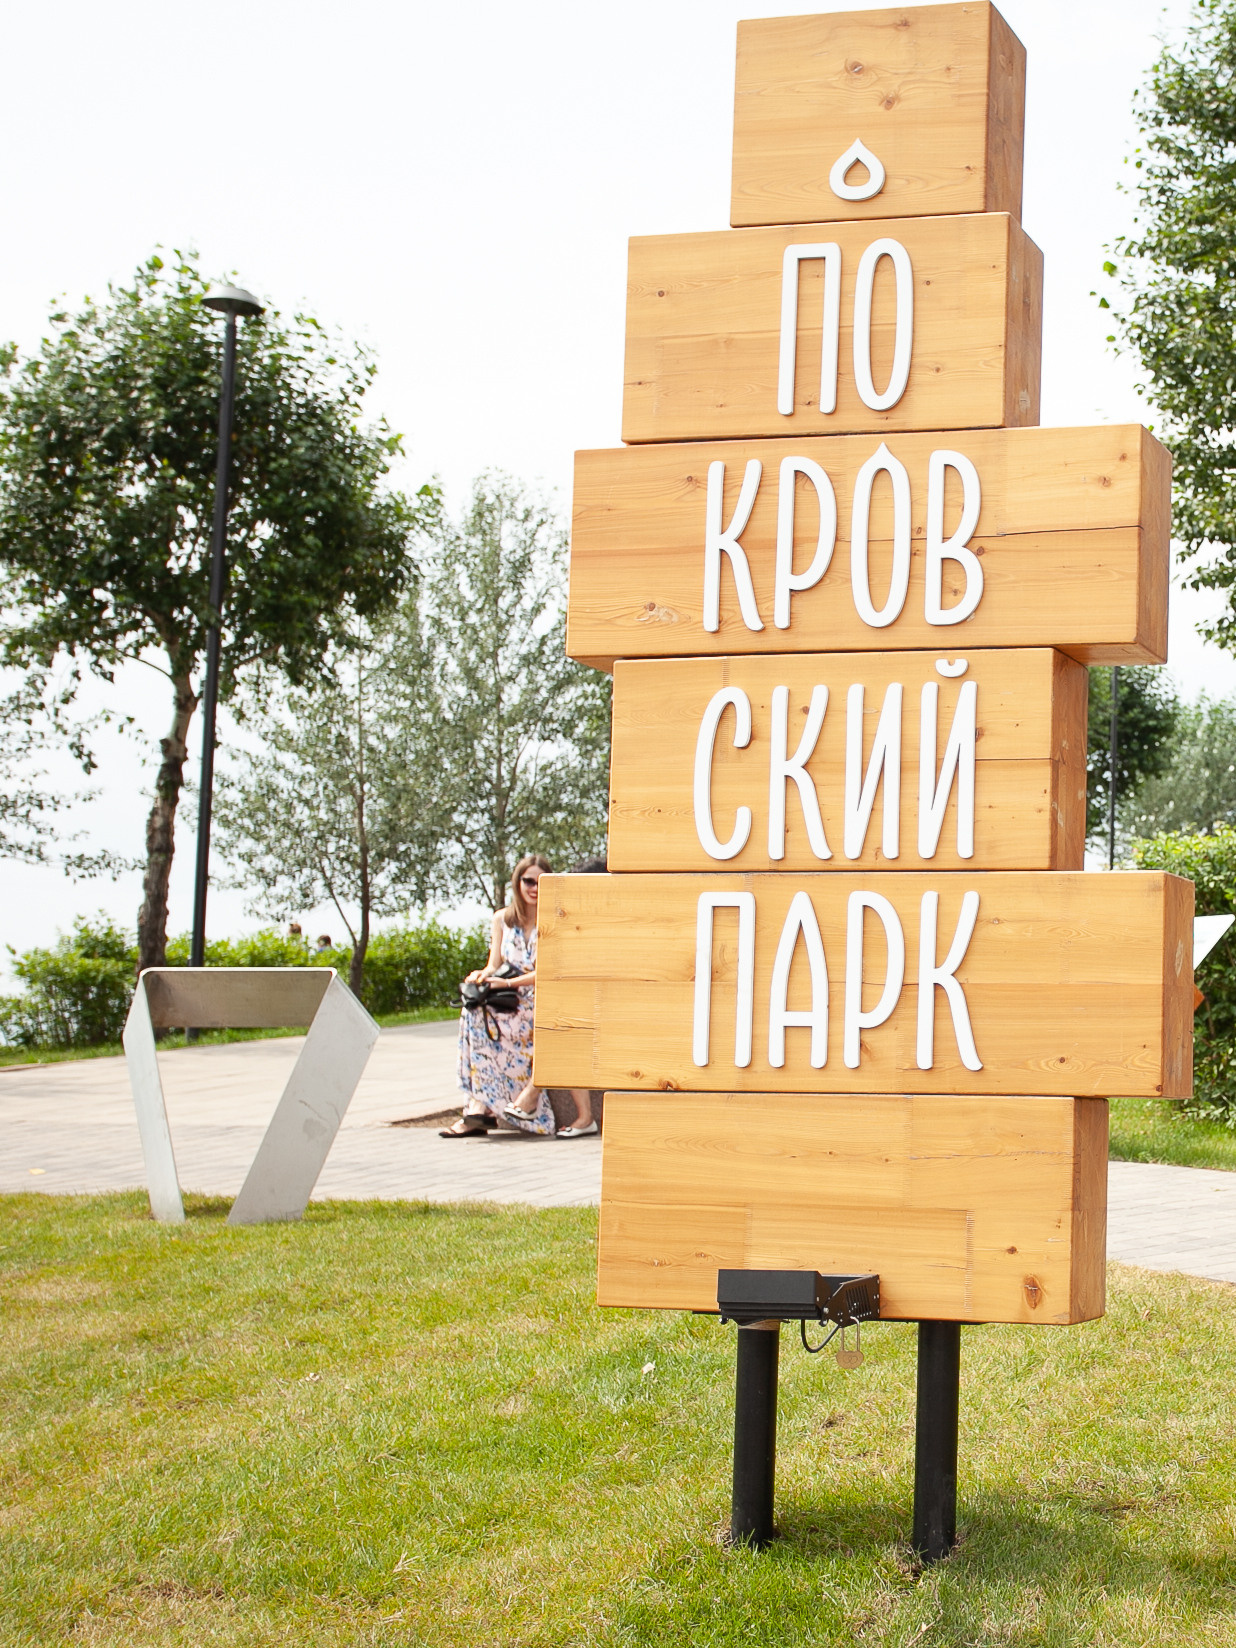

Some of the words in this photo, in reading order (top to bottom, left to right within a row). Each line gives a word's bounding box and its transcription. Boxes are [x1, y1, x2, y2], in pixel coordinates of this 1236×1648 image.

[777, 237, 914, 416] ПО
[702, 442, 986, 633] КРОВ
[692, 658, 978, 861] СКИЙ
[692, 890, 984, 1071] ПАРК
